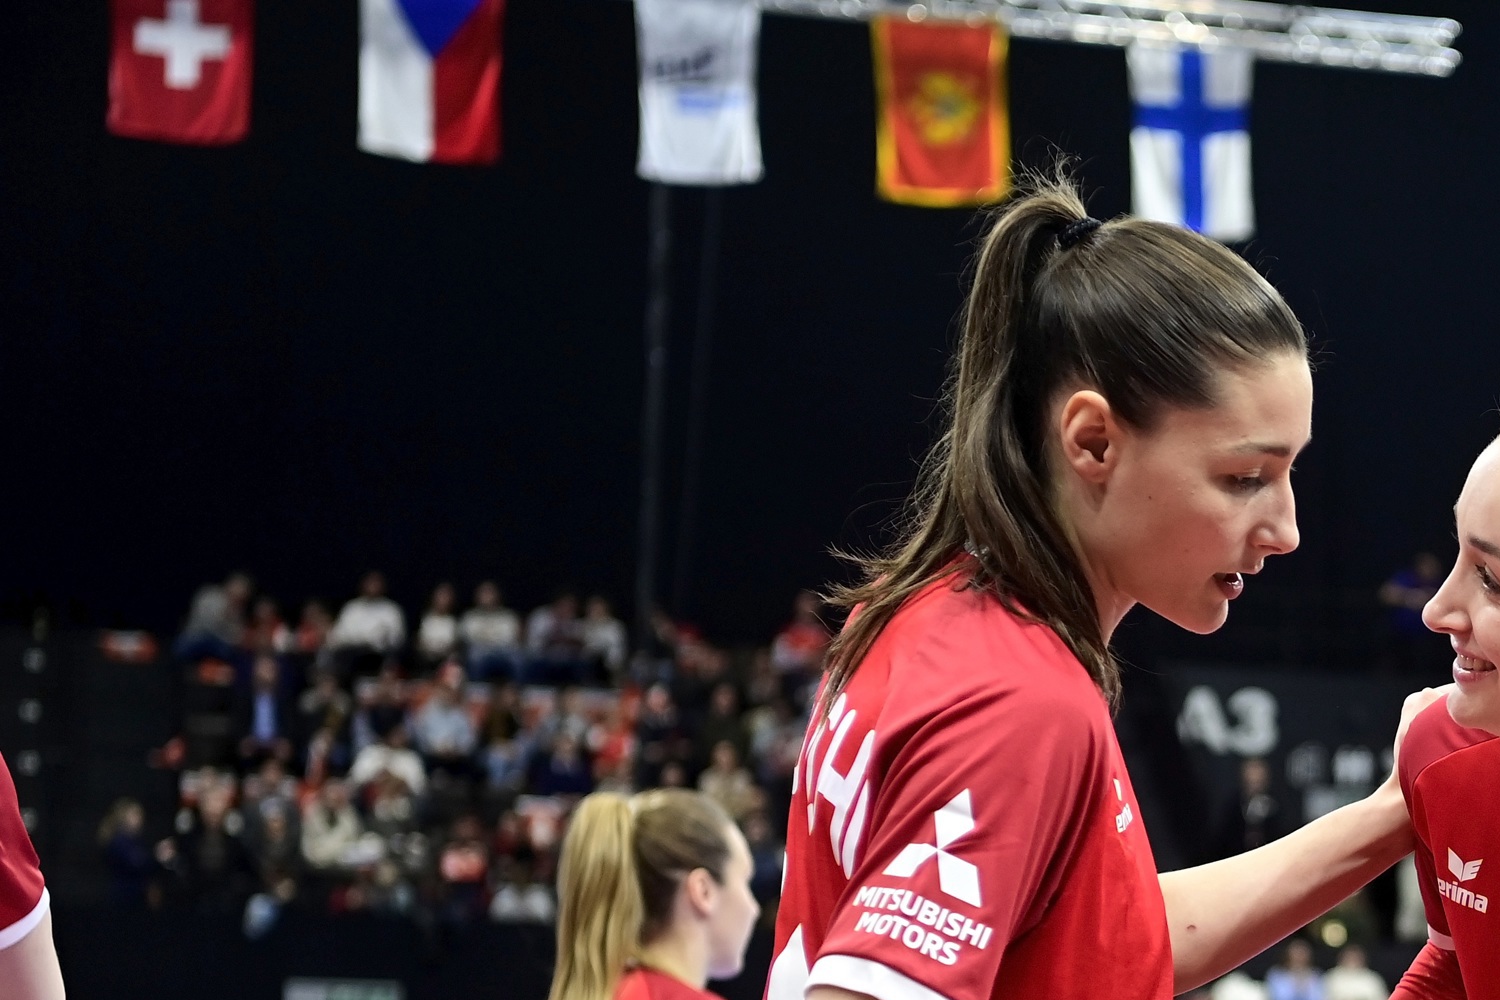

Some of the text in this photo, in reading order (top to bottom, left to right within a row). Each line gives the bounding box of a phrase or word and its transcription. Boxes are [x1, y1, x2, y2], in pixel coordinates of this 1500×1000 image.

[1178, 685, 1279, 757] A3
[853, 886, 993, 950] MITSUBISHI
[1437, 877, 1488, 914] erima
[854, 912, 962, 966] MOTORS
